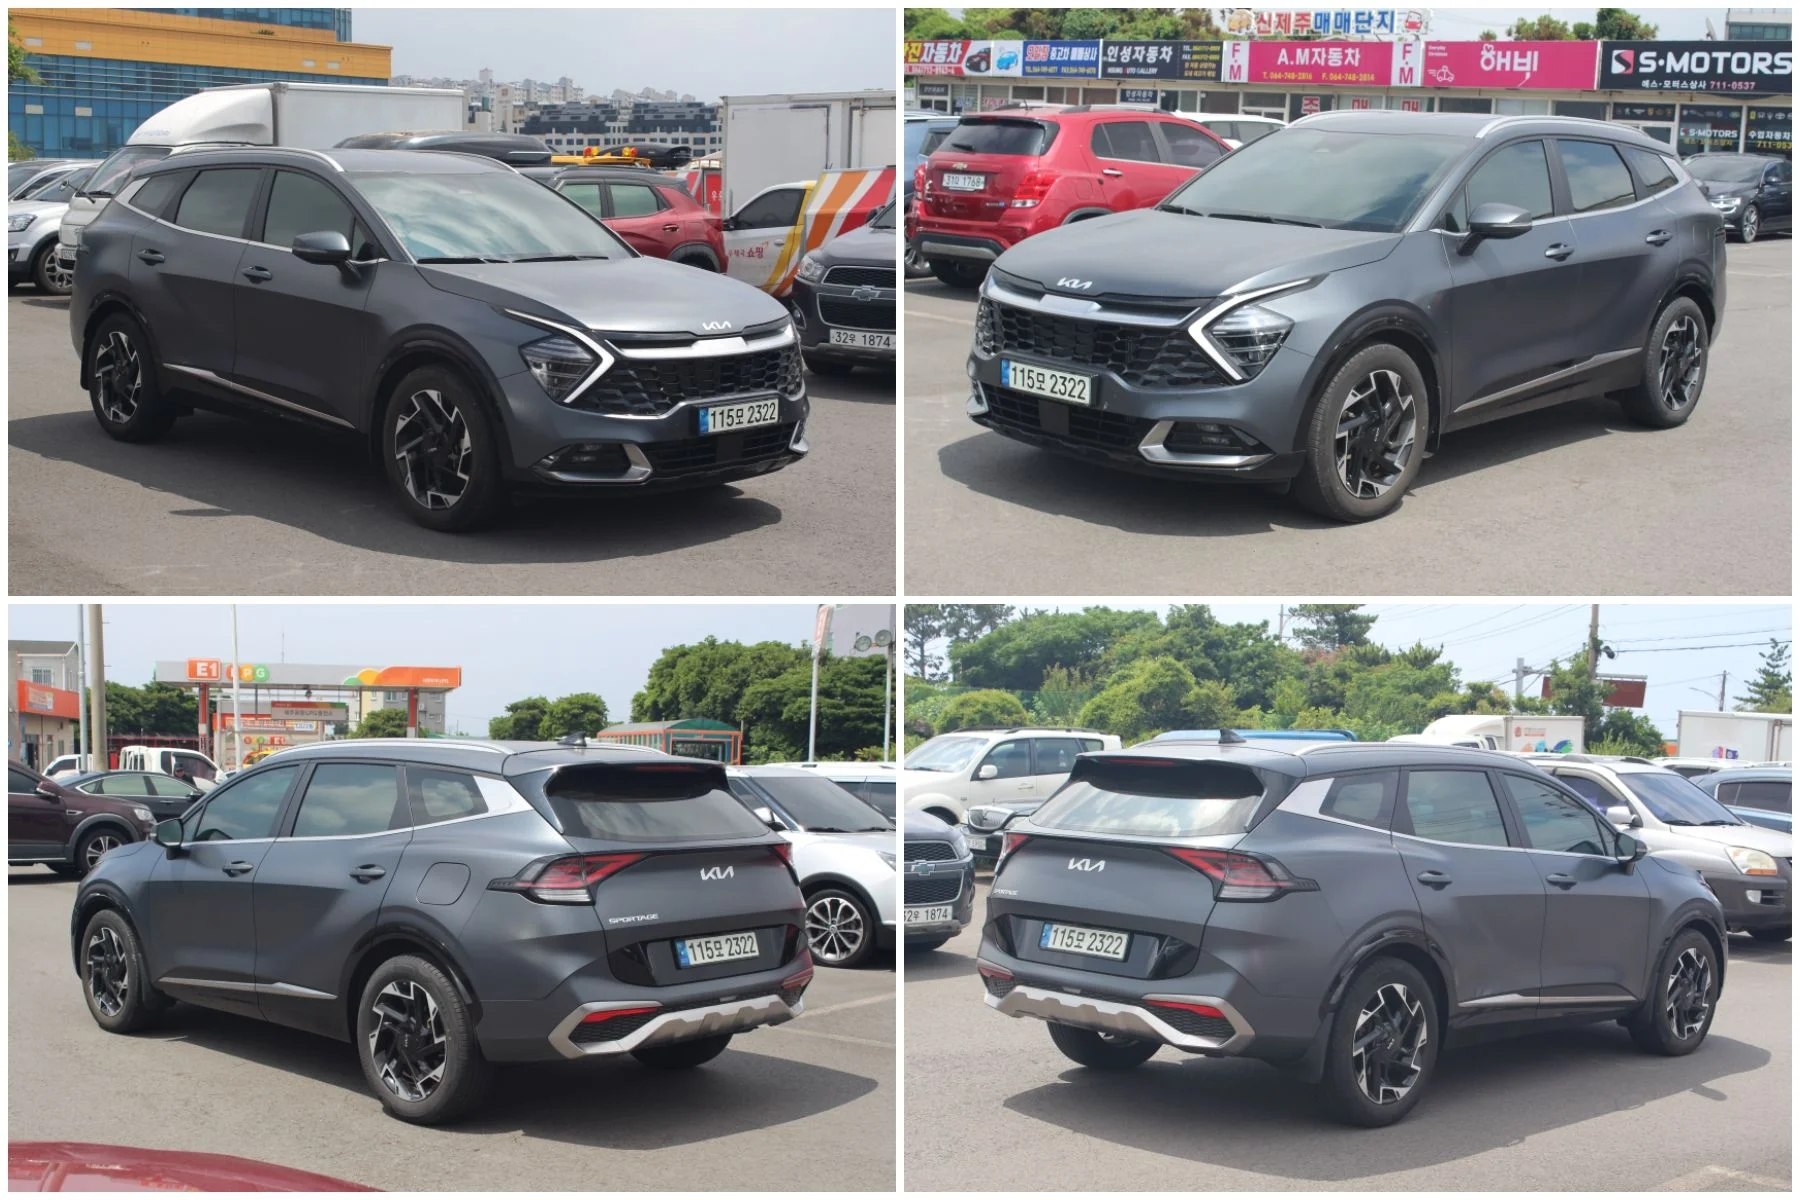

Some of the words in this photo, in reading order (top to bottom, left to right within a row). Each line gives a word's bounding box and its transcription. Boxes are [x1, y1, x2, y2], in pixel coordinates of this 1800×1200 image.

[1256, 11, 1396, 34] 신제주매매단지
[1107, 45, 1173, 63] 인성자동차
[1277, 48, 1361, 67] A.M자동차
[963, 176, 981, 187] 1768
[1057, 277, 1092, 290] KIA
[702, 321, 732, 331] KIA
[835, 331, 856, 344] 32우
[862, 334, 891, 348] 1874
[1011, 366, 1046, 391] 115모
[1050, 374, 1086, 400] 2322
[711, 407, 744, 429] 115모
[747, 402, 776, 425] 2322
[196, 662, 218, 677] E1
[1067, 857, 1106, 872] KIA
[700, 865, 735, 881] KIA
[608, 913, 660, 924] SPORTAGE
[924, 908, 948, 918] 1874
[688, 940, 724, 962] 115모
[725, 935, 757, 957] 2322
[1052, 927, 1086, 949] 115모
[1086, 932, 1123, 955] 2322
